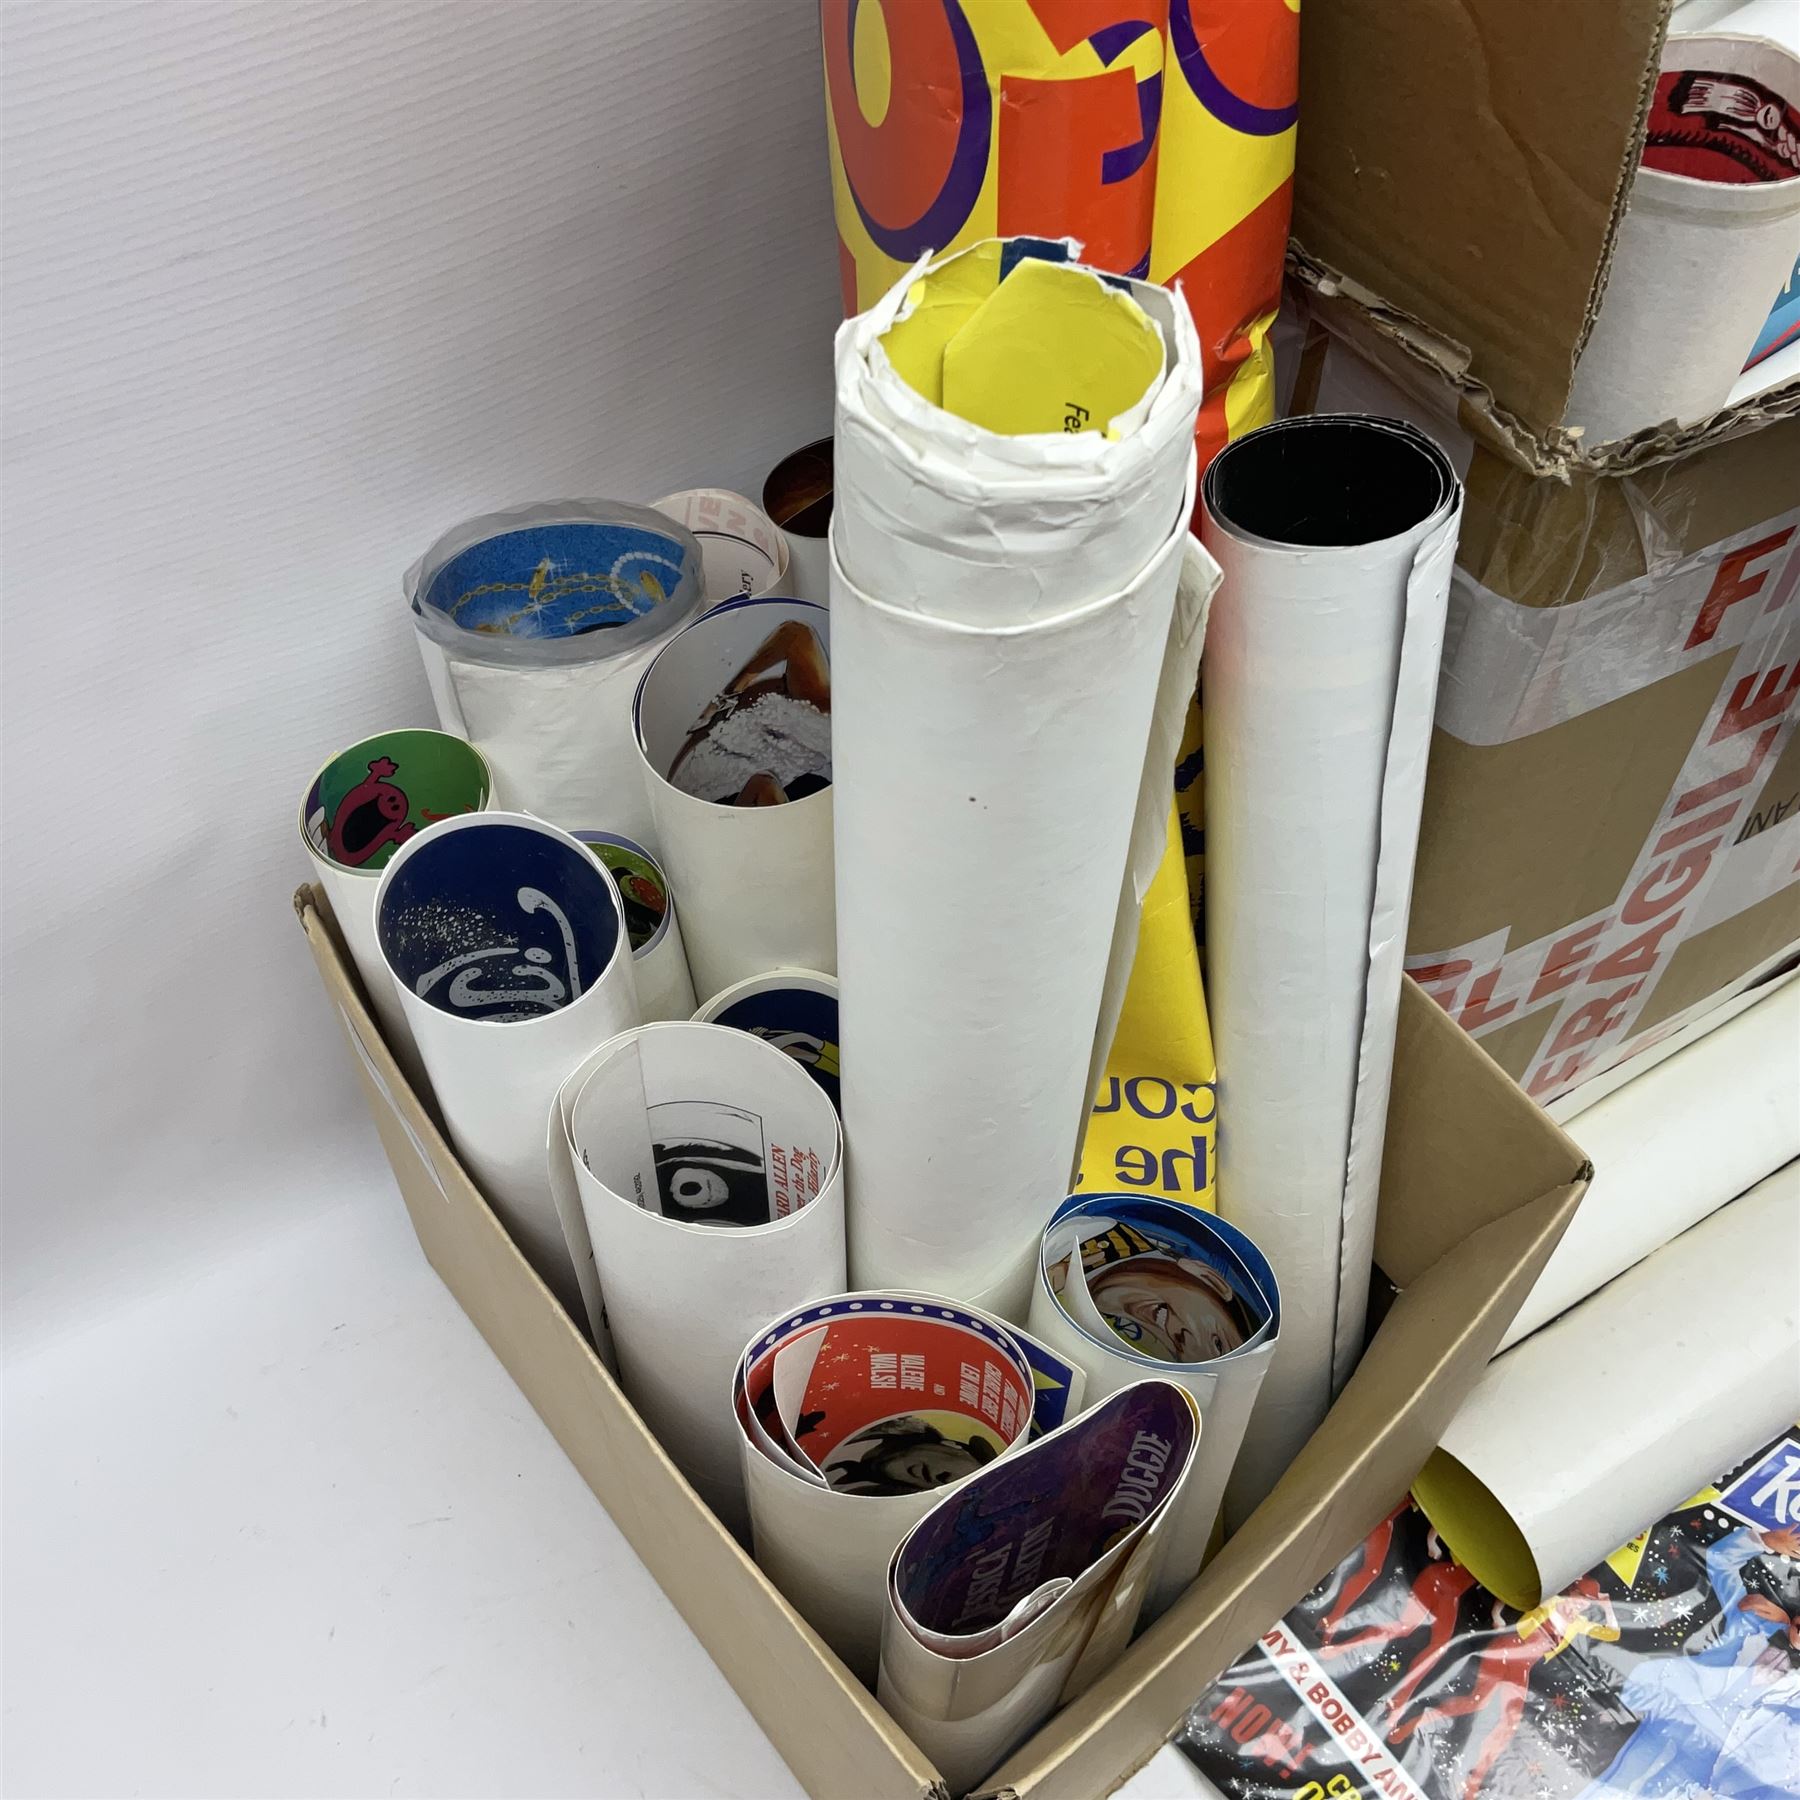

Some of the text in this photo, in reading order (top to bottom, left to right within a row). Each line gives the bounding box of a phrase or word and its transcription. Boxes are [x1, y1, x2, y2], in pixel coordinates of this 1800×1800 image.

[771, 1143, 789, 1191] ALLEN
[791, 1146, 807, 1174] Dog
[792, 1173, 805, 1193] the
[870, 1353, 898, 1389] WALSH
[900, 1354, 926, 1392] VALERIE
[960, 1361, 981, 1384] LEN
[1101, 1429, 1172, 1521] DUGGIE
[1289, 1661, 1310, 1686] &
[1306, 1681, 1384, 1765] BOBBY
